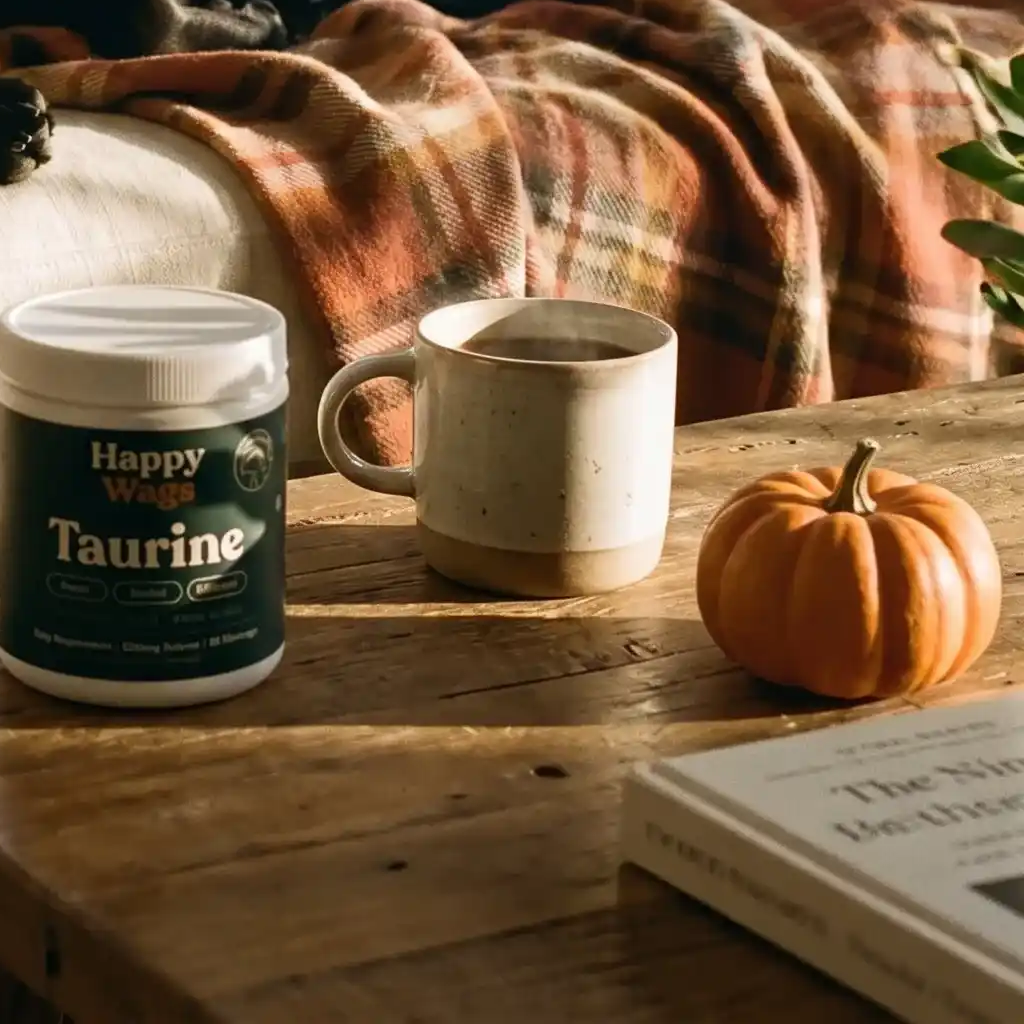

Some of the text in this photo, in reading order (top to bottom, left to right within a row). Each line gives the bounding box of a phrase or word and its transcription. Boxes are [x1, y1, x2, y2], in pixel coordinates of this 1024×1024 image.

[91, 441, 205, 478] Happy
[102, 477, 195, 510] Wags
[48, 516, 245, 569] Taurine
